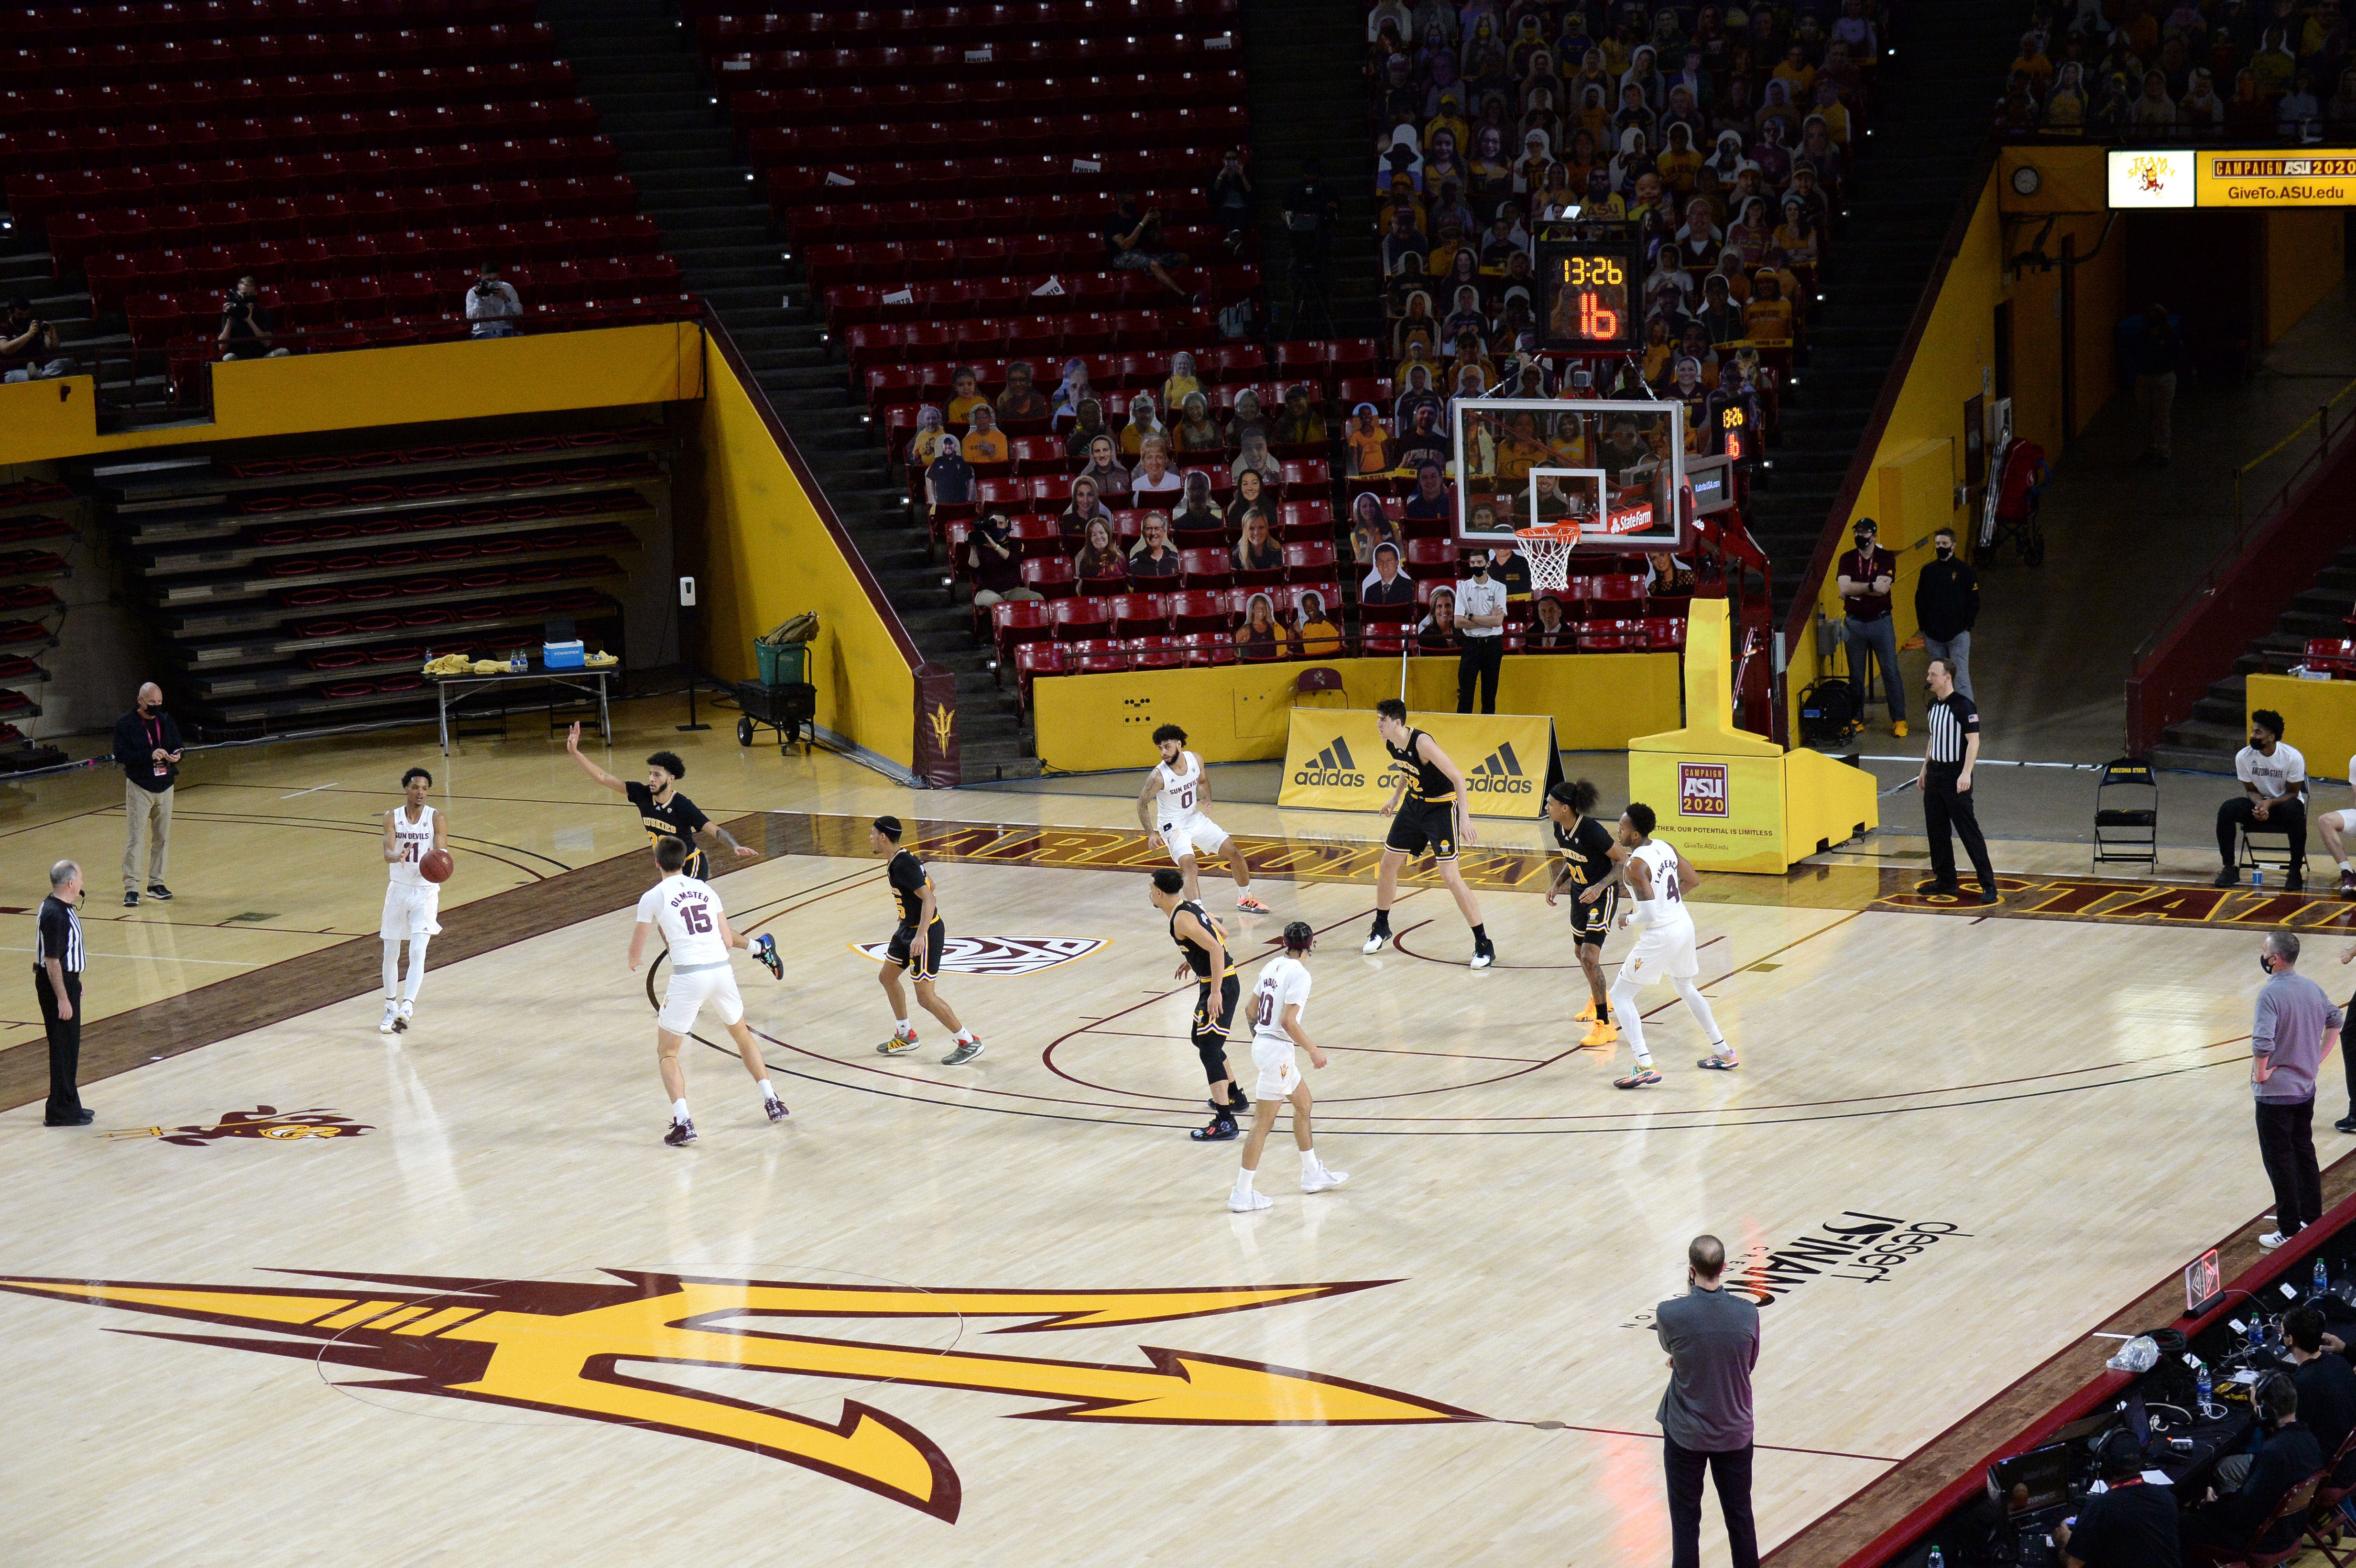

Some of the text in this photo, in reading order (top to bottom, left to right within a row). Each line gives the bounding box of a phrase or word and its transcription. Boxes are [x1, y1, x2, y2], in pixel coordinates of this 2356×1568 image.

[2133, 156, 2168, 167] TEAM
[2216, 161, 2356, 175] CAMPAIGN ASU 2020
[2127, 165, 2175, 178] SPAKY
[2228, 186, 2344, 199] GiveTo.ASU.edu
[1587, 205, 1618, 215] ASU
[1564, 257, 1622, 284] 13:26
[1582, 293, 1616, 339] 16
[1723, 406, 1743, 428] 13:26
[1294, 768, 1364, 788] adidas
[1684, 768, 1723, 778] CAMPAIGN
[2251, 767, 2283, 778] ARIZONA STATE
[1169, 778, 1199, 795] SUN DEVILS
[1466, 773, 1532, 794] adidas
[1683, 777, 1723, 798] ASU
[1181, 790, 1193, 809] 0
[1683, 798, 1724, 812] 2020
[404, 842, 419, 863] 11
[1567, 862, 1588, 884] 21
[1667, 874, 1680, 904] 4
[671, 891, 709, 907] OLMSTED
[680, 904, 713, 935] 15
[1830, 1221, 1974, 1284] desert
